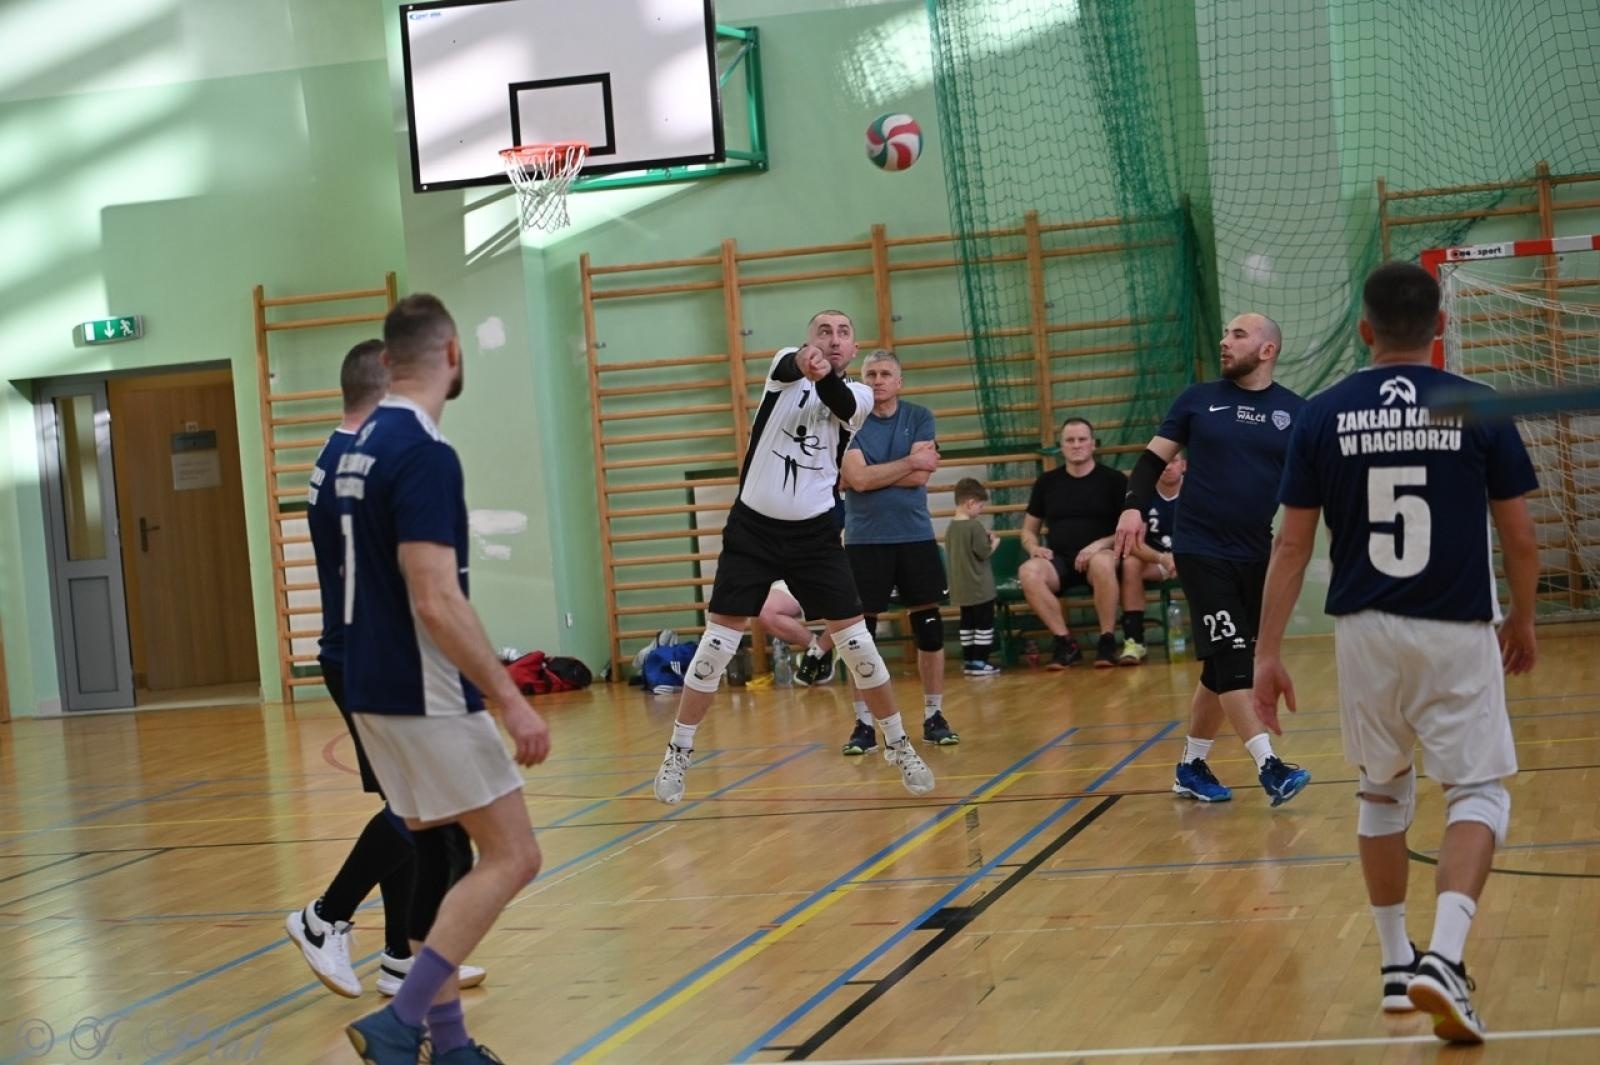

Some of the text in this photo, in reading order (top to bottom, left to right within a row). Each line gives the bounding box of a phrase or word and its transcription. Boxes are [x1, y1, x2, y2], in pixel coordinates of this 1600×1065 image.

[1336, 408, 1401, 433] ZAKŁAD
[1339, 429, 1462, 456] W RACIBORZU
[1367, 466, 1431, 578] 5
[1203, 609, 1236, 641] 23
